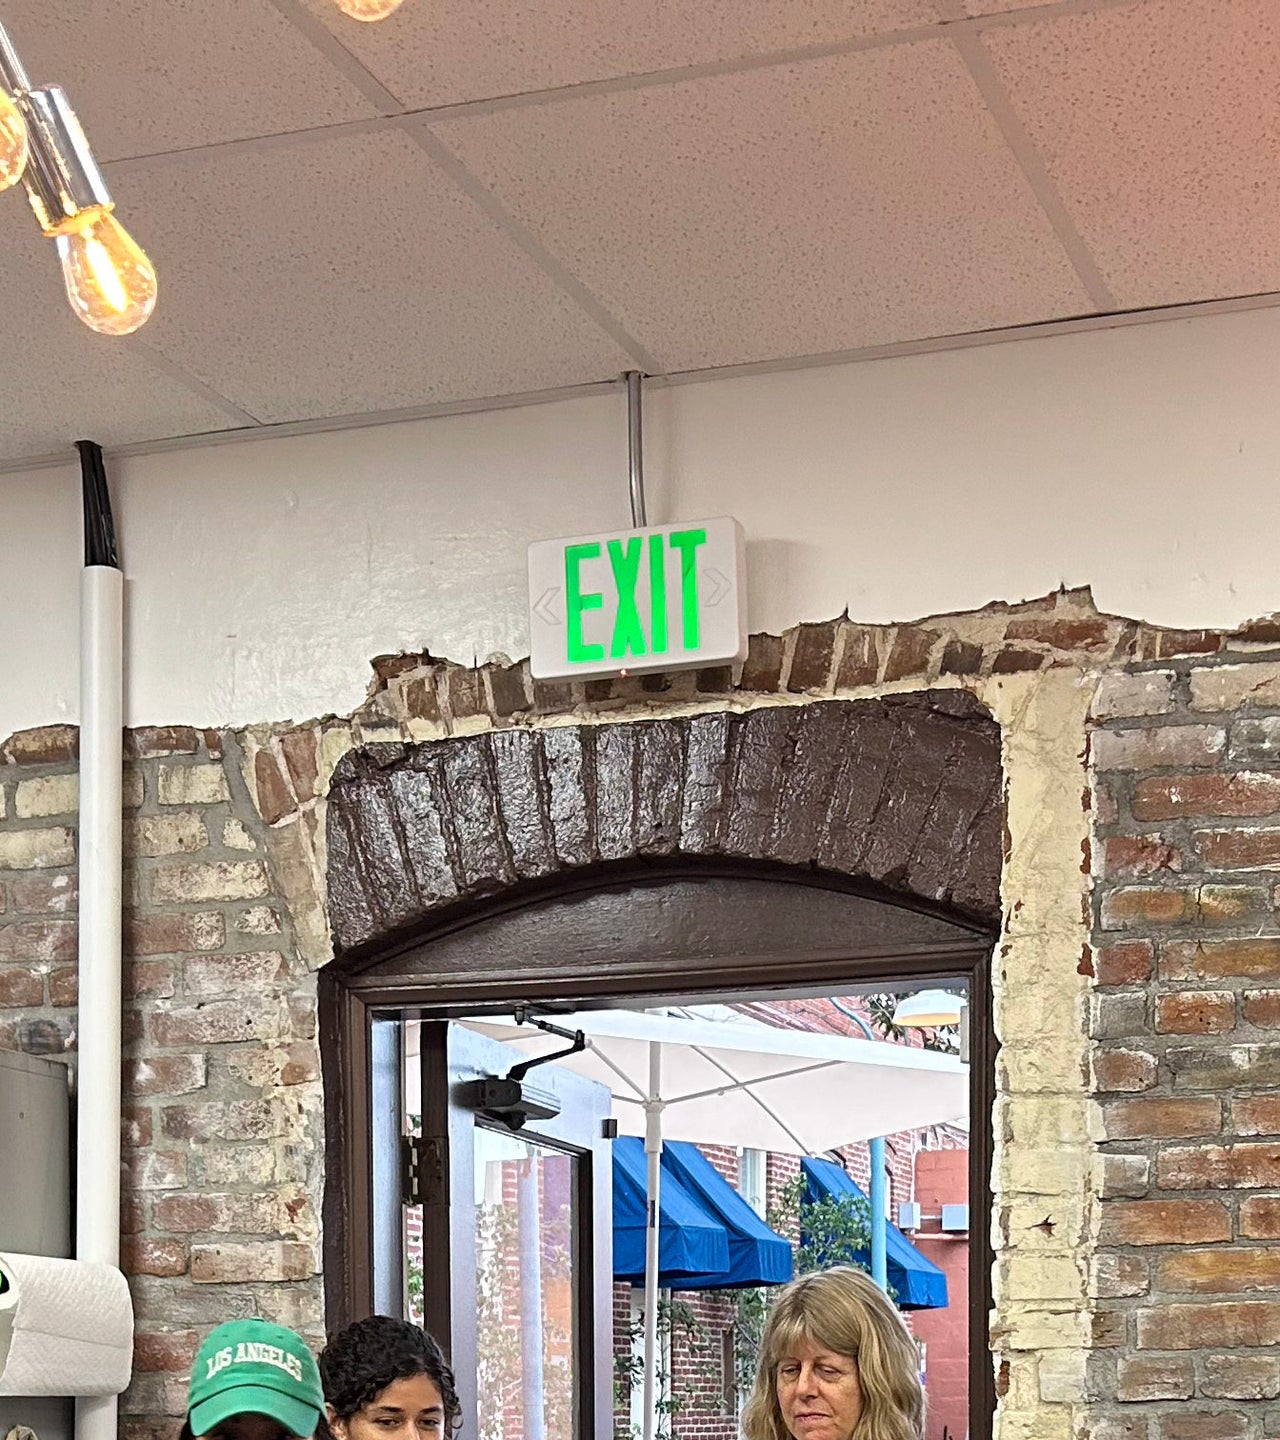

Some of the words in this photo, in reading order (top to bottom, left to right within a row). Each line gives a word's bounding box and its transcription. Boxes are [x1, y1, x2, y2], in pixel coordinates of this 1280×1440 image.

[565, 528, 707, 663] EXIT
[206, 1346, 233, 1380] LOS
[234, 1342, 302, 1382] ANGELES
